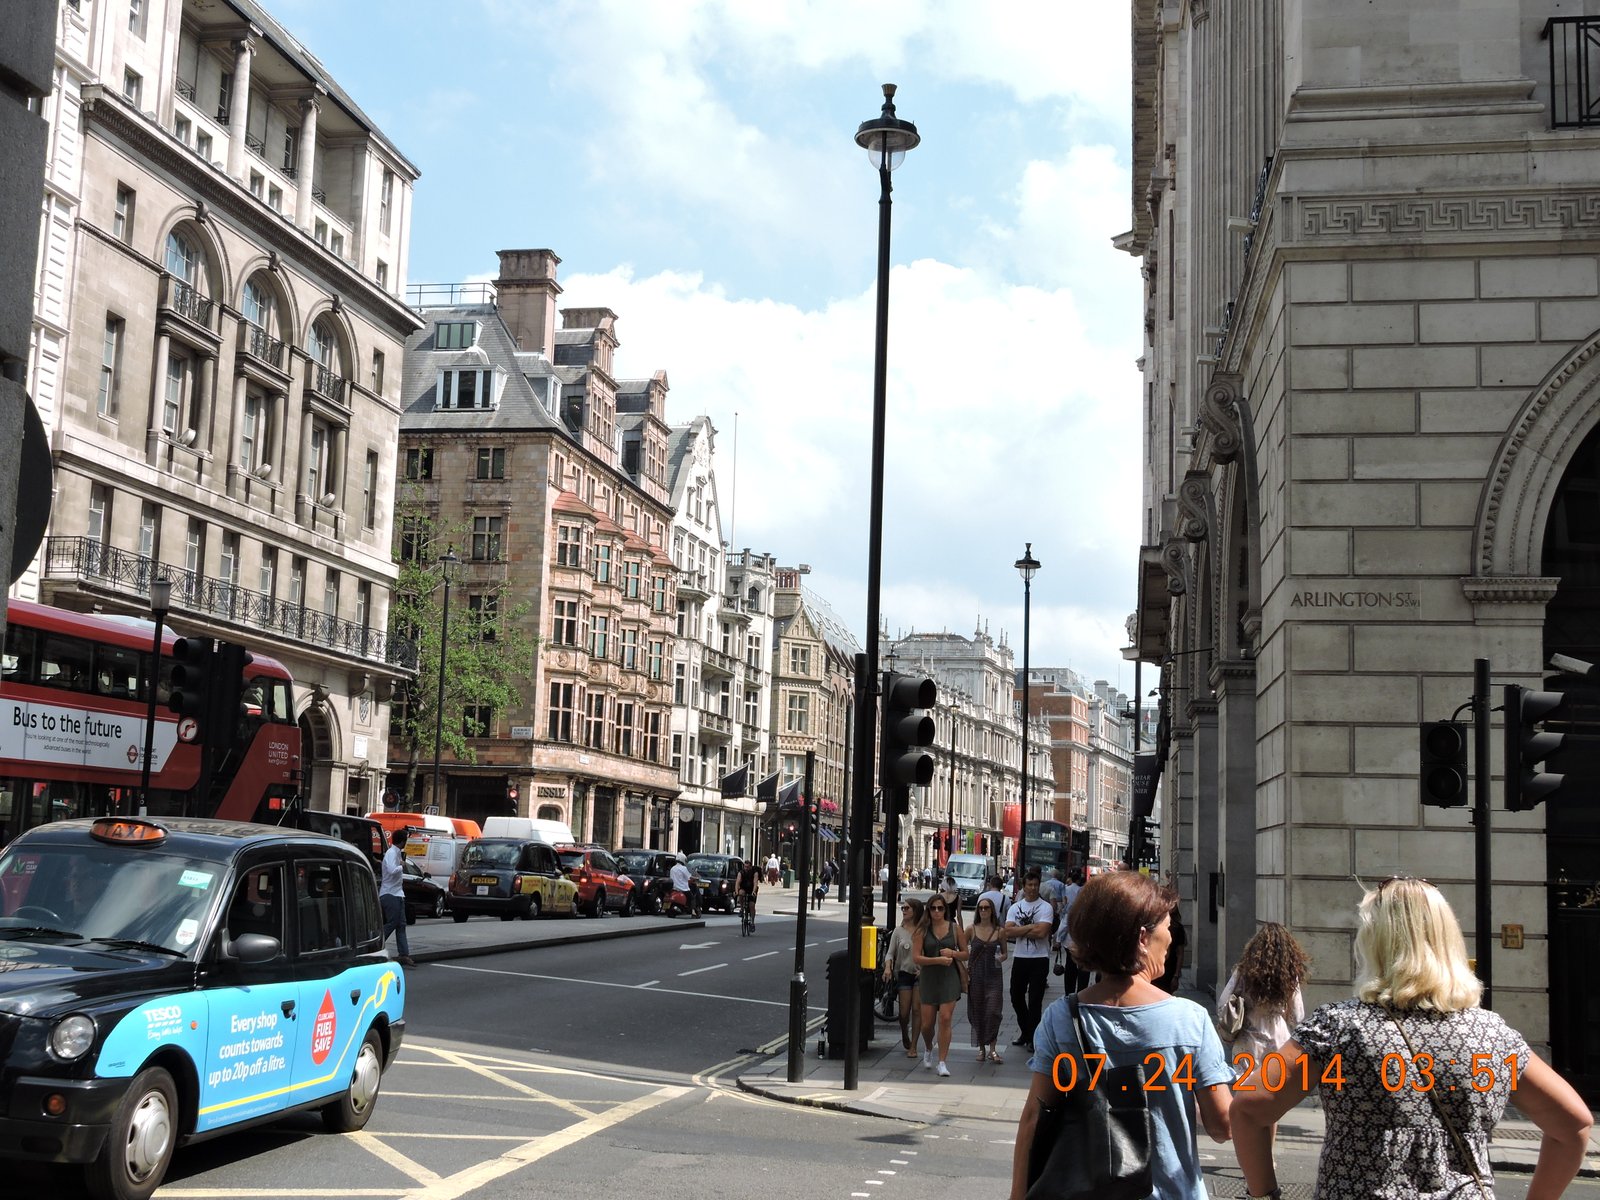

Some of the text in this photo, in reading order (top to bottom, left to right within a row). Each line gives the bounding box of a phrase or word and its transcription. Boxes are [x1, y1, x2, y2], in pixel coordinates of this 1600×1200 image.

[1290, 591, 1392, 607] ARLINGTON
[13, 706, 122, 739] Bus to the future
[103, 823, 147, 839] TAXI
[143, 1005, 182, 1022] TESCO
[231, 1010, 278, 1034] Every shop
[316, 1021, 333, 1037] FUEL
[219, 1031, 284, 1059] counts towards
[313, 1036, 331, 1053] SAVE
[208, 1069, 221, 1088] up
[222, 1067, 232, 1082] to
[232, 1061, 249, 1082] 20p
[249, 1056, 264, 1076] off
[262, 1060, 268, 1073] a
